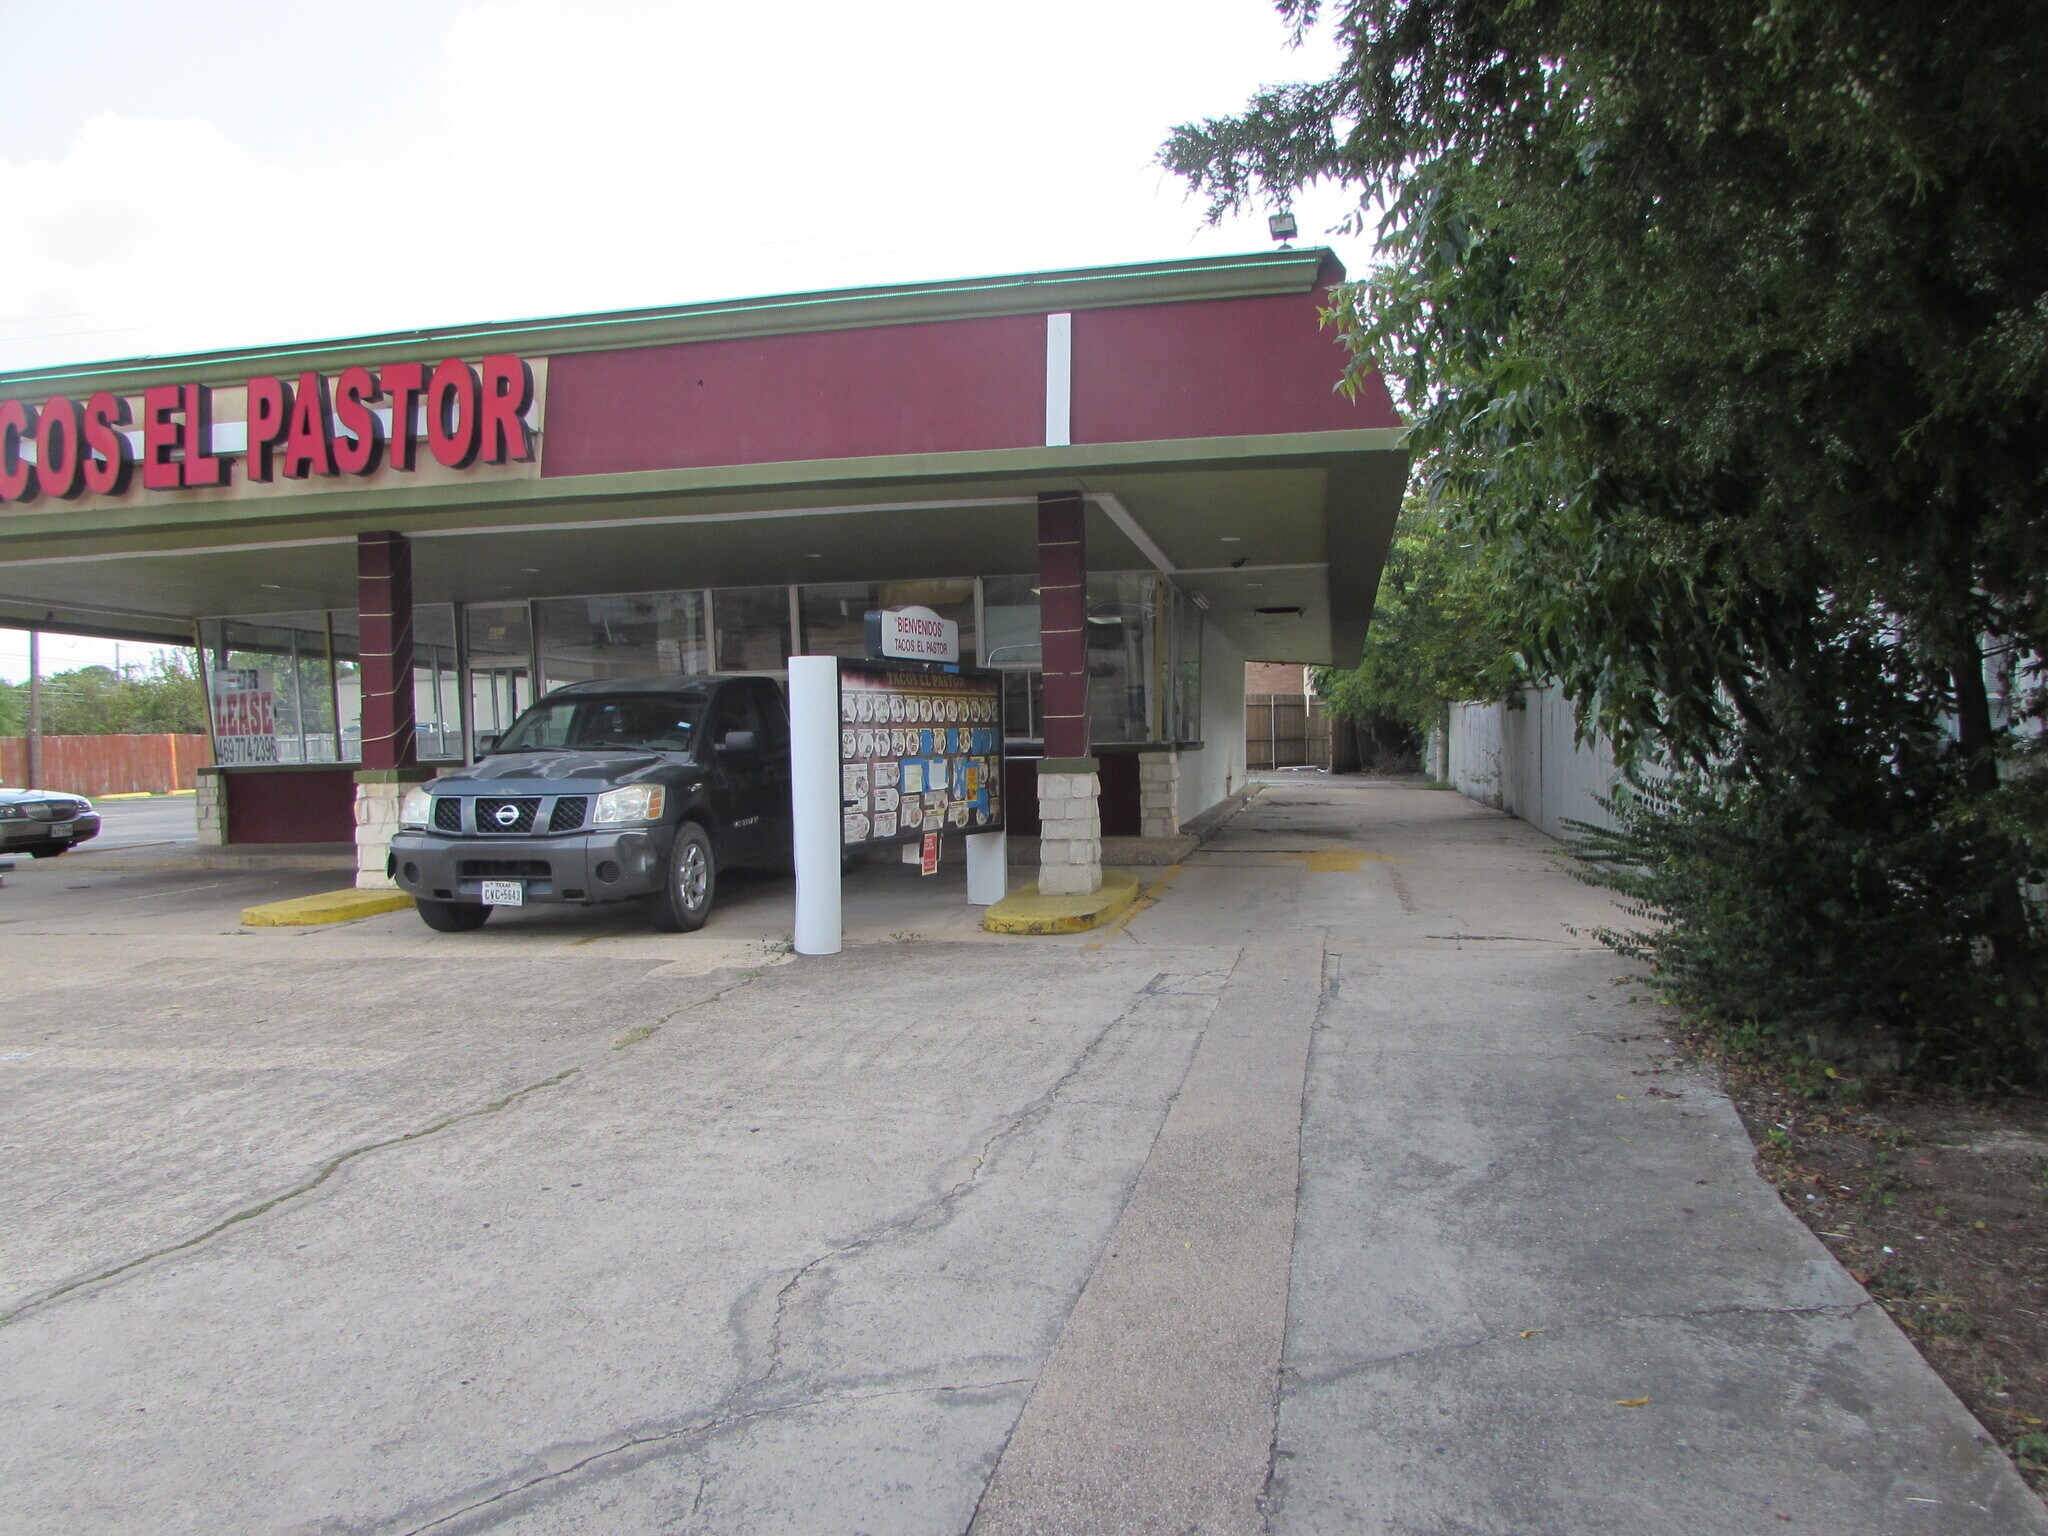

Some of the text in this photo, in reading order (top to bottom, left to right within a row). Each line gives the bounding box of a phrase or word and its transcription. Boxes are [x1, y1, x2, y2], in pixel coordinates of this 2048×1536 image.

[144, 383, 229, 490] EL
[247, 354, 535, 482] PASTOR
[895, 638, 948, 655] TACOS EL PASTOR
[886, 671, 919, 686] TACOS
[919, 673, 931, 687] EL
[217, 692, 274, 736] LEASE
